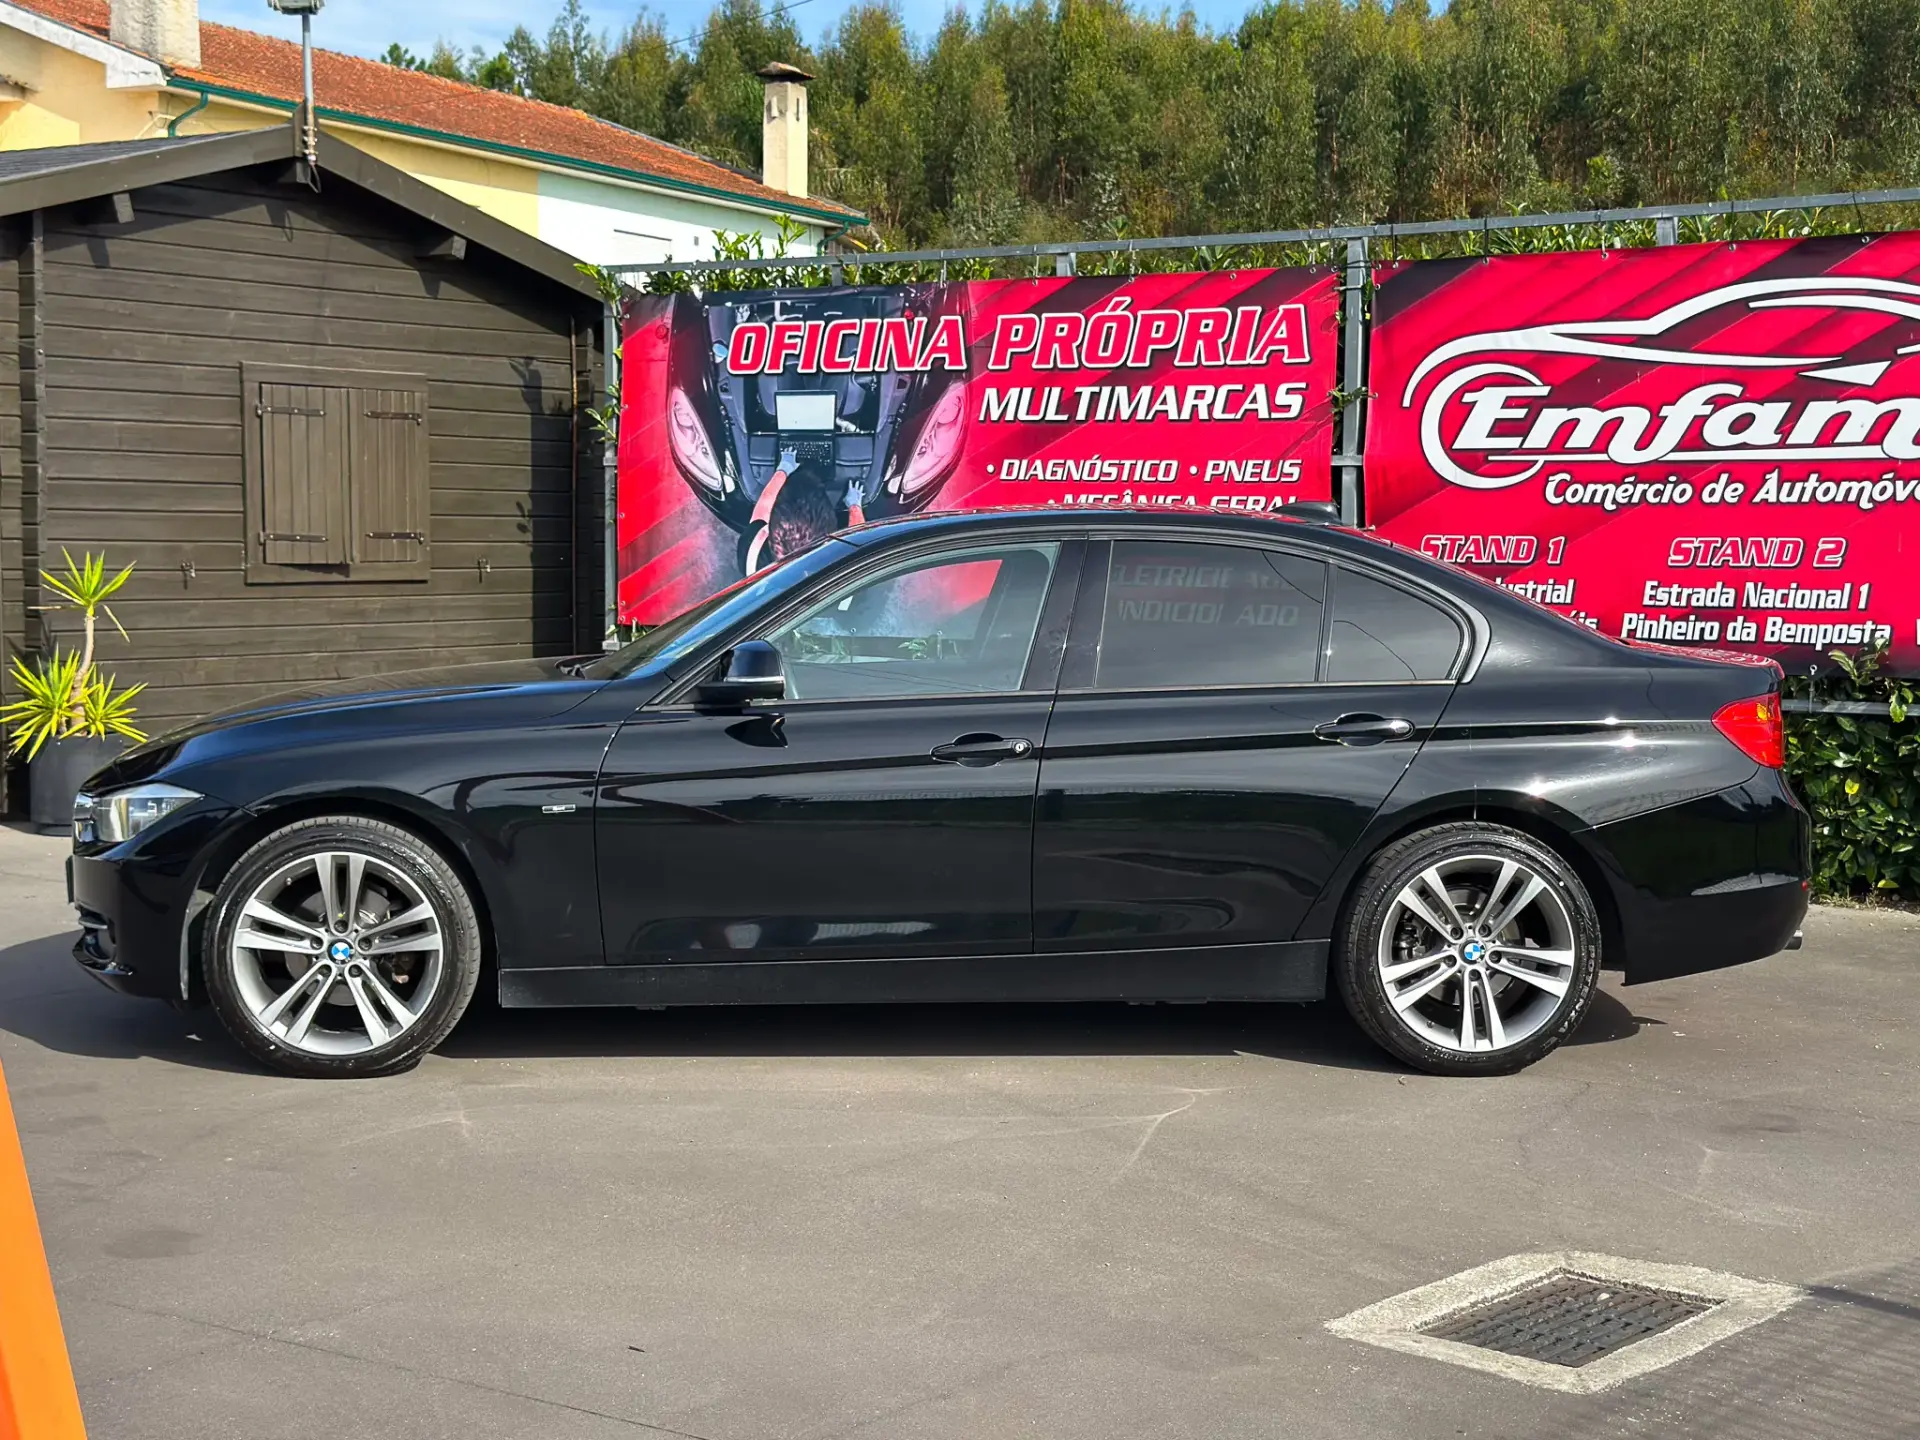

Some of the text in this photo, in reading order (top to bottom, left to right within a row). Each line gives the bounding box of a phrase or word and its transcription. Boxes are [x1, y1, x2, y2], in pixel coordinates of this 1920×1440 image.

[728, 297, 1312, 374] OFICINA PRÓPRIA
[978, 382, 1307, 421] MULTIMARCAS
[1000, 454, 1302, 482] DIAGNÓSTICO PNEUS
[1210, 495, 1297, 512] GERA
[1545, 472, 1693, 511] Comércio
[1701, 473, 1745, 504] de
[1421, 535, 1566, 565] STAND 1
[1667, 537, 1847, 568] STAND 2
[1642, 580, 1871, 610] Estrada Nacional 1
[1620, 612, 1720, 641] Pinheiro
[1726, 616, 1758, 642] da
[1764, 616, 1891, 651] Bemposta
